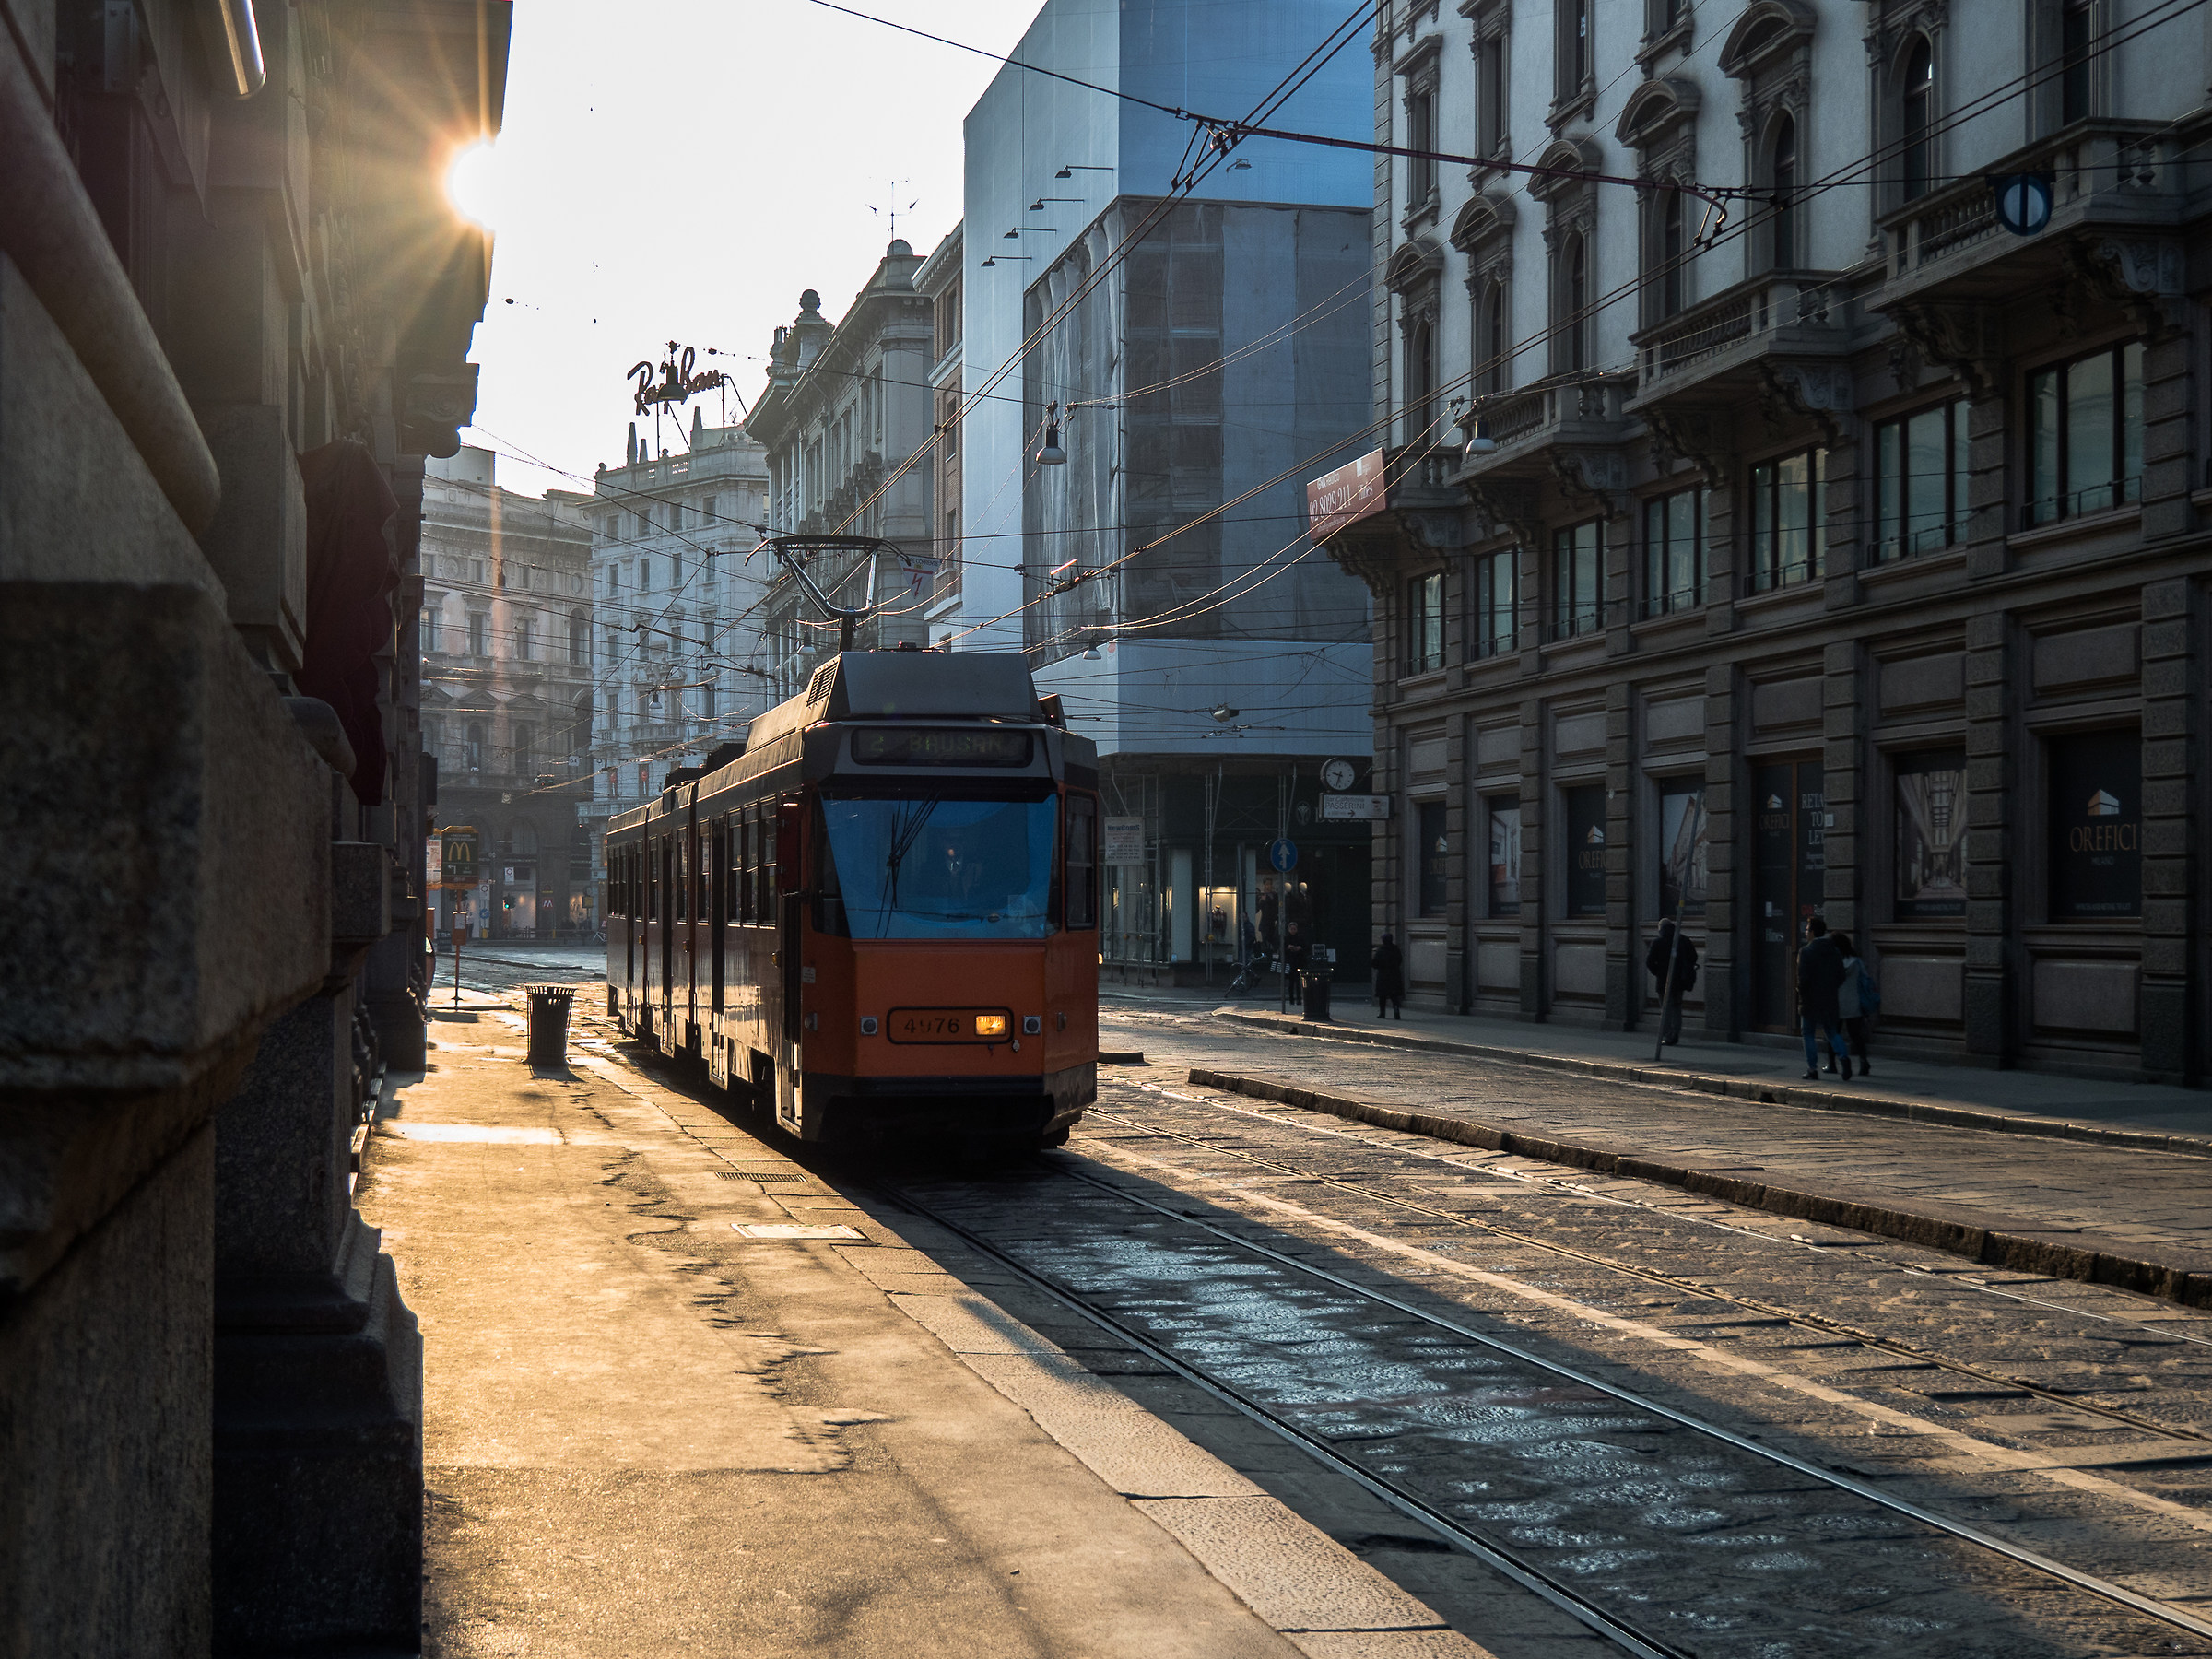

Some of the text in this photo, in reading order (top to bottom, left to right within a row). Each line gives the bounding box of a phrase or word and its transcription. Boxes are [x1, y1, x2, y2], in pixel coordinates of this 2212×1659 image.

[1309, 500, 1319, 523] 02
[870, 735, 885, 753] 2
[1324, 802, 1365, 810] PASSERINI
[1810, 811, 1824, 827] TO
[2069, 823, 2137, 853] OREFICI
